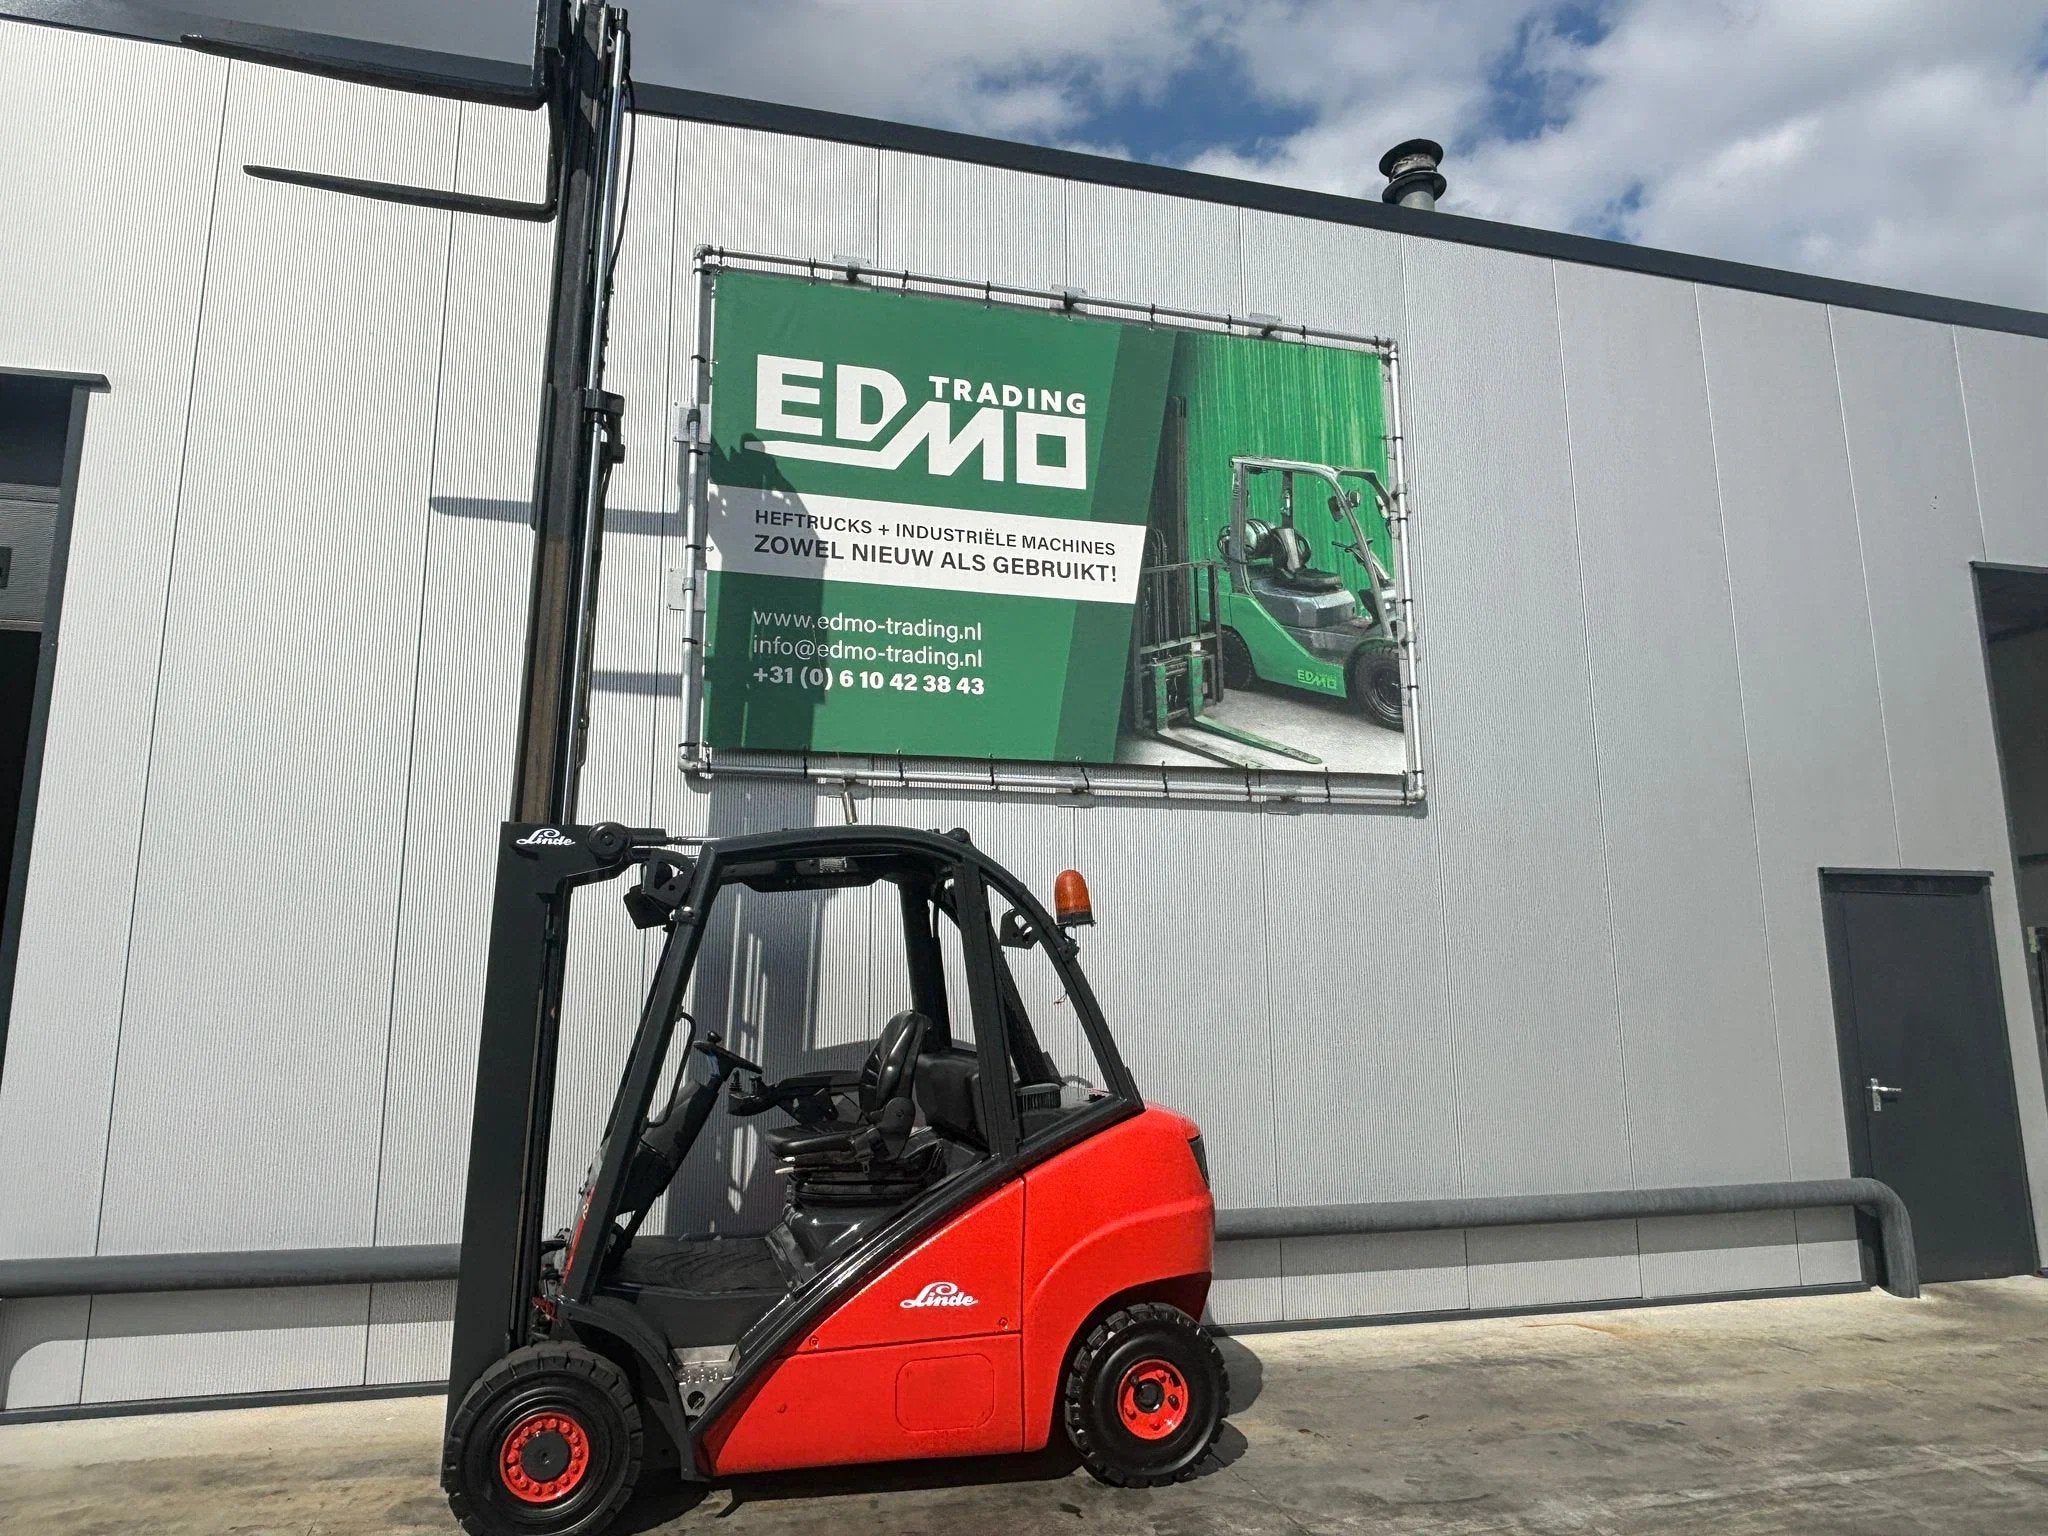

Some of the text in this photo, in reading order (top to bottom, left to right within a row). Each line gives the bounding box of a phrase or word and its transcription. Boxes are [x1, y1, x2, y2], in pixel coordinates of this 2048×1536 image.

[928, 375, 1086, 415] TRADING
[745, 354, 1087, 490] EDMO
[755, 509, 872, 534] HEFTRUCKS
[896, 523, 1017, 548] INDUSTRIËLE
[1022, 535, 1116, 556] MACHINES
[754, 534, 1117, 583] ZOWEL NIEUW ALS GEBRUIKT!
[753, 610, 982, 643] www.edmo-trading.nl
[753, 634, 983, 670] info@edmo-trading.nl
[753, 665, 985, 695] +31 (0) 6 10 42 38 43
[516, 828, 576, 846] Linde
[900, 1281, 979, 1309] Linde
